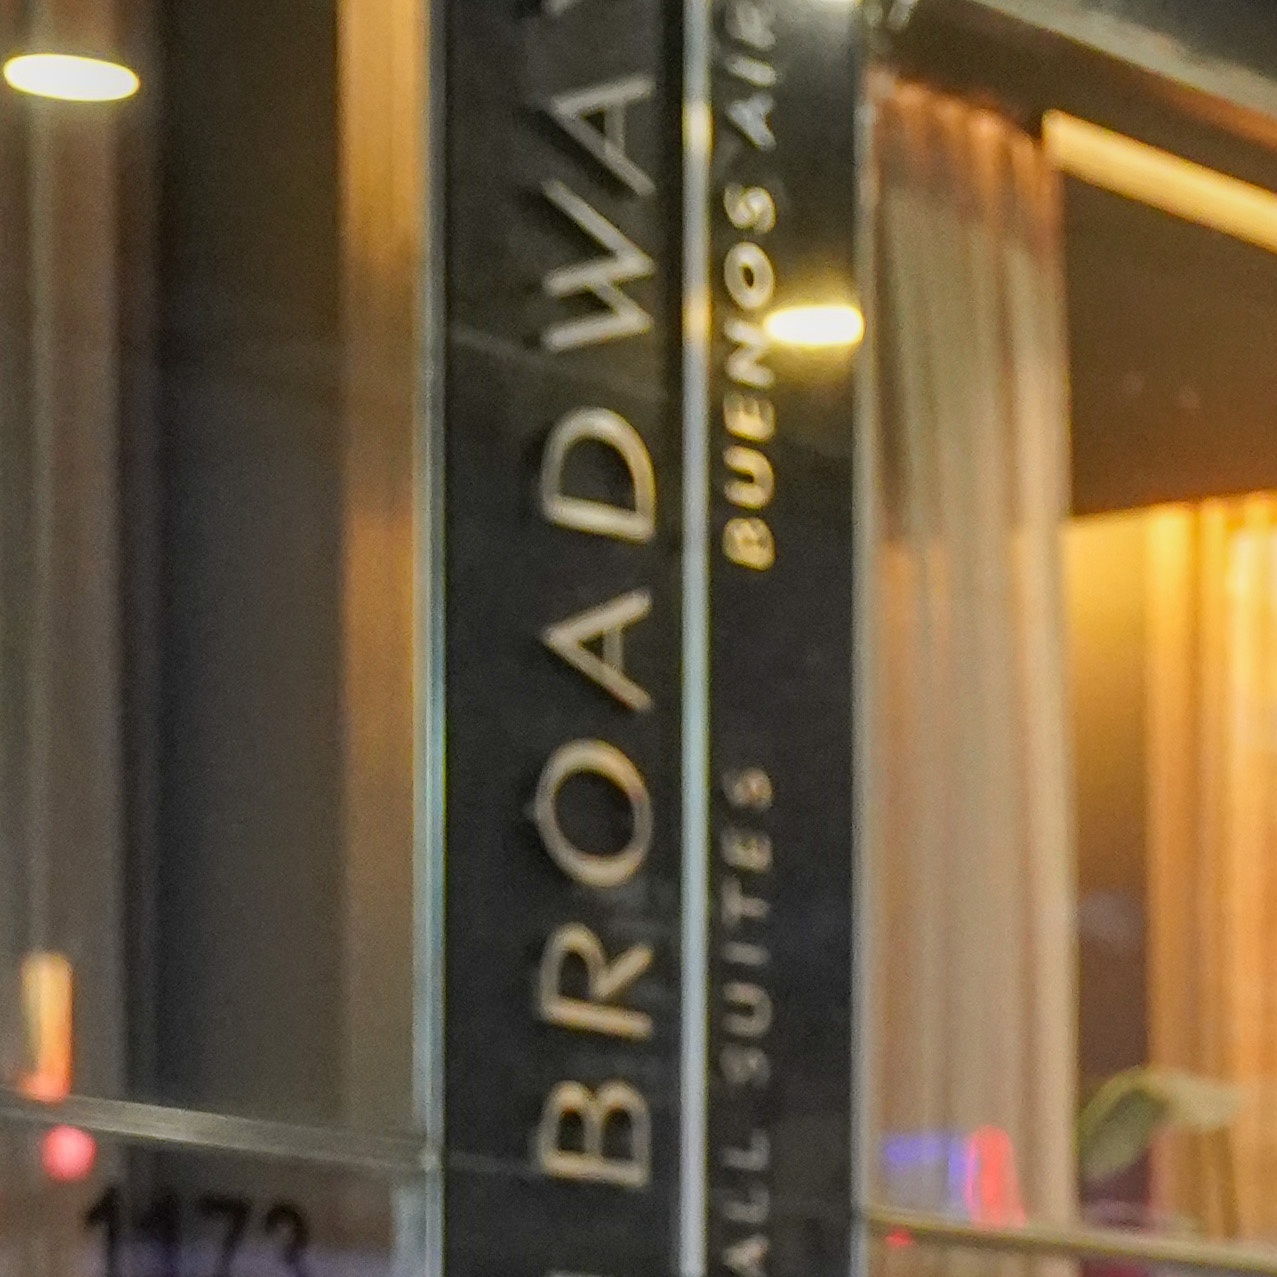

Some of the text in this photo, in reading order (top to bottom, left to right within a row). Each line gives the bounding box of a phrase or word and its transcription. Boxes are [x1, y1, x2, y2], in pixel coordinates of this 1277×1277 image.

[723, 184, 776, 570] BUENOS
[536, 0, 657, 1186] BROADWA
[721, 764, 773, 1089] SUITES
